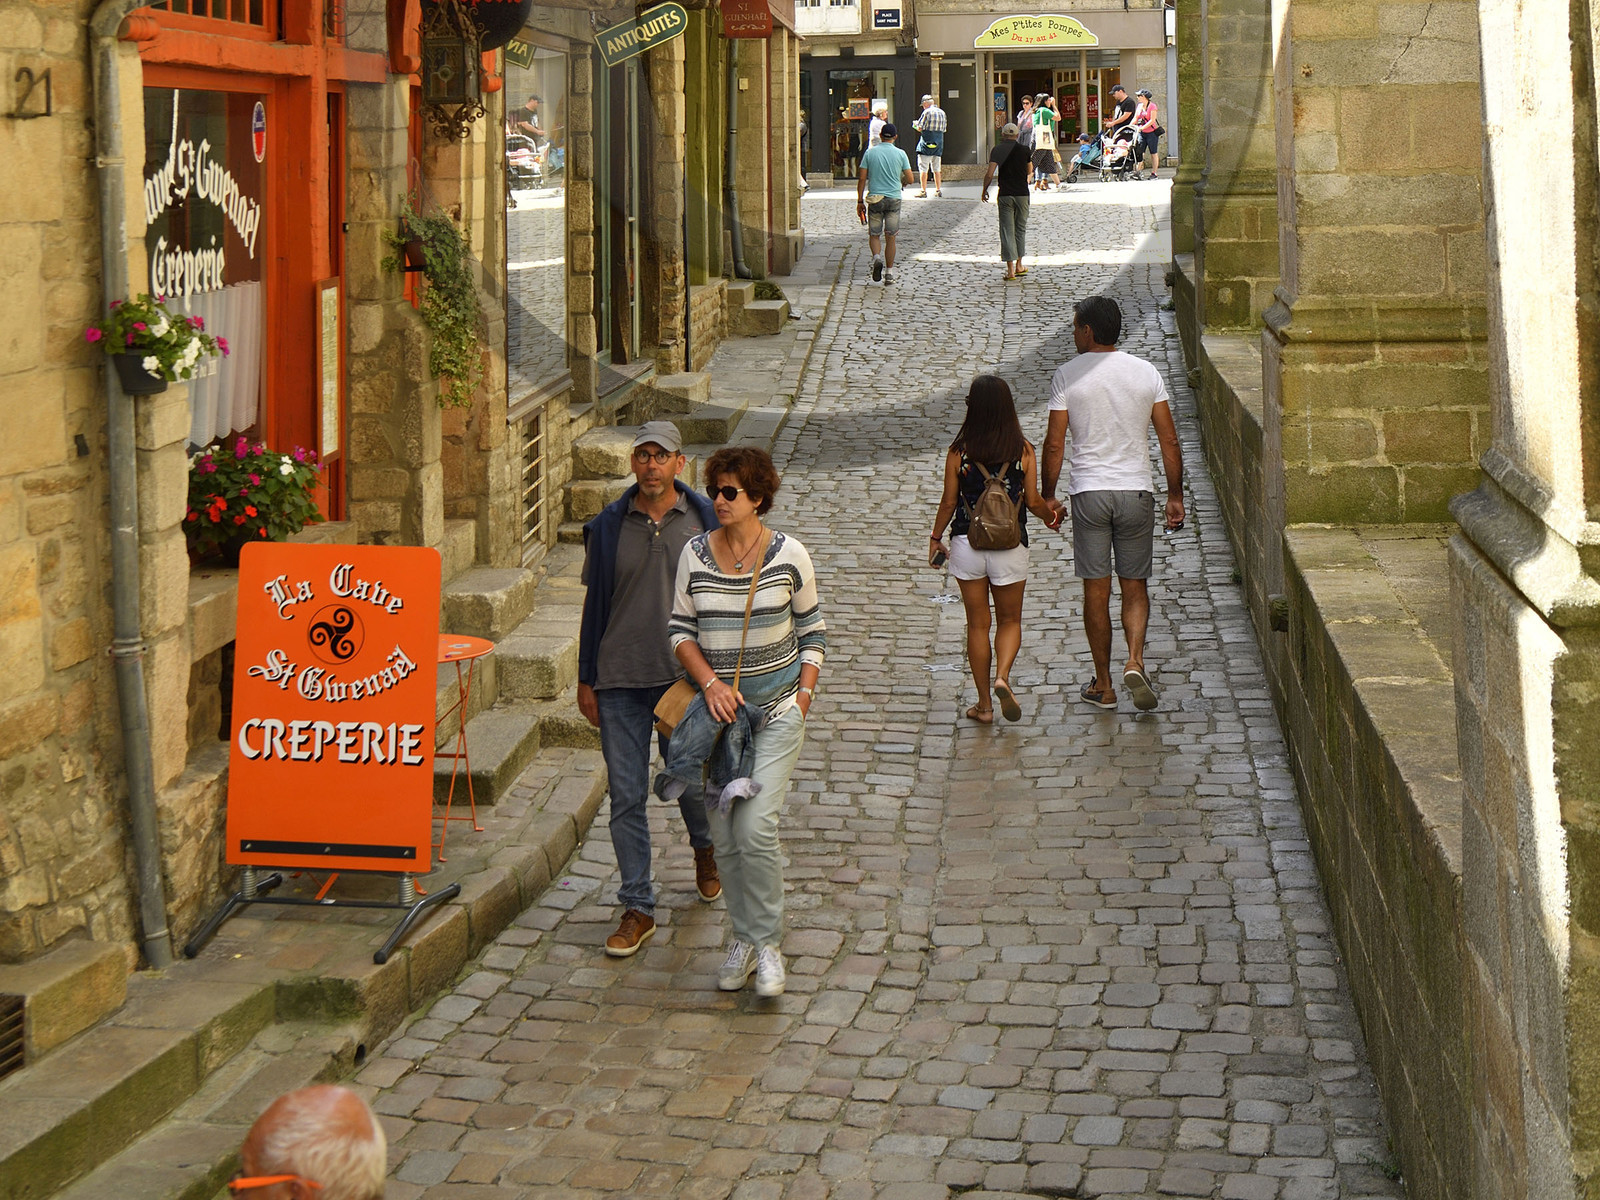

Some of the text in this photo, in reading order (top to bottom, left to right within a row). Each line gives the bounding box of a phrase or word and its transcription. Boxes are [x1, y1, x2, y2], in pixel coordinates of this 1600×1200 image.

[989, 19, 1083, 40] Mes P'tites Pompes
[1011, 33, 1023, 42] Du
[6, 67, 51, 118] 21
[144, 160, 175, 224] ave
[264, 563, 404, 620] La Cave
[247, 643, 417, 702] St Gwenaël
[238, 717, 424, 767] CREPERIE
